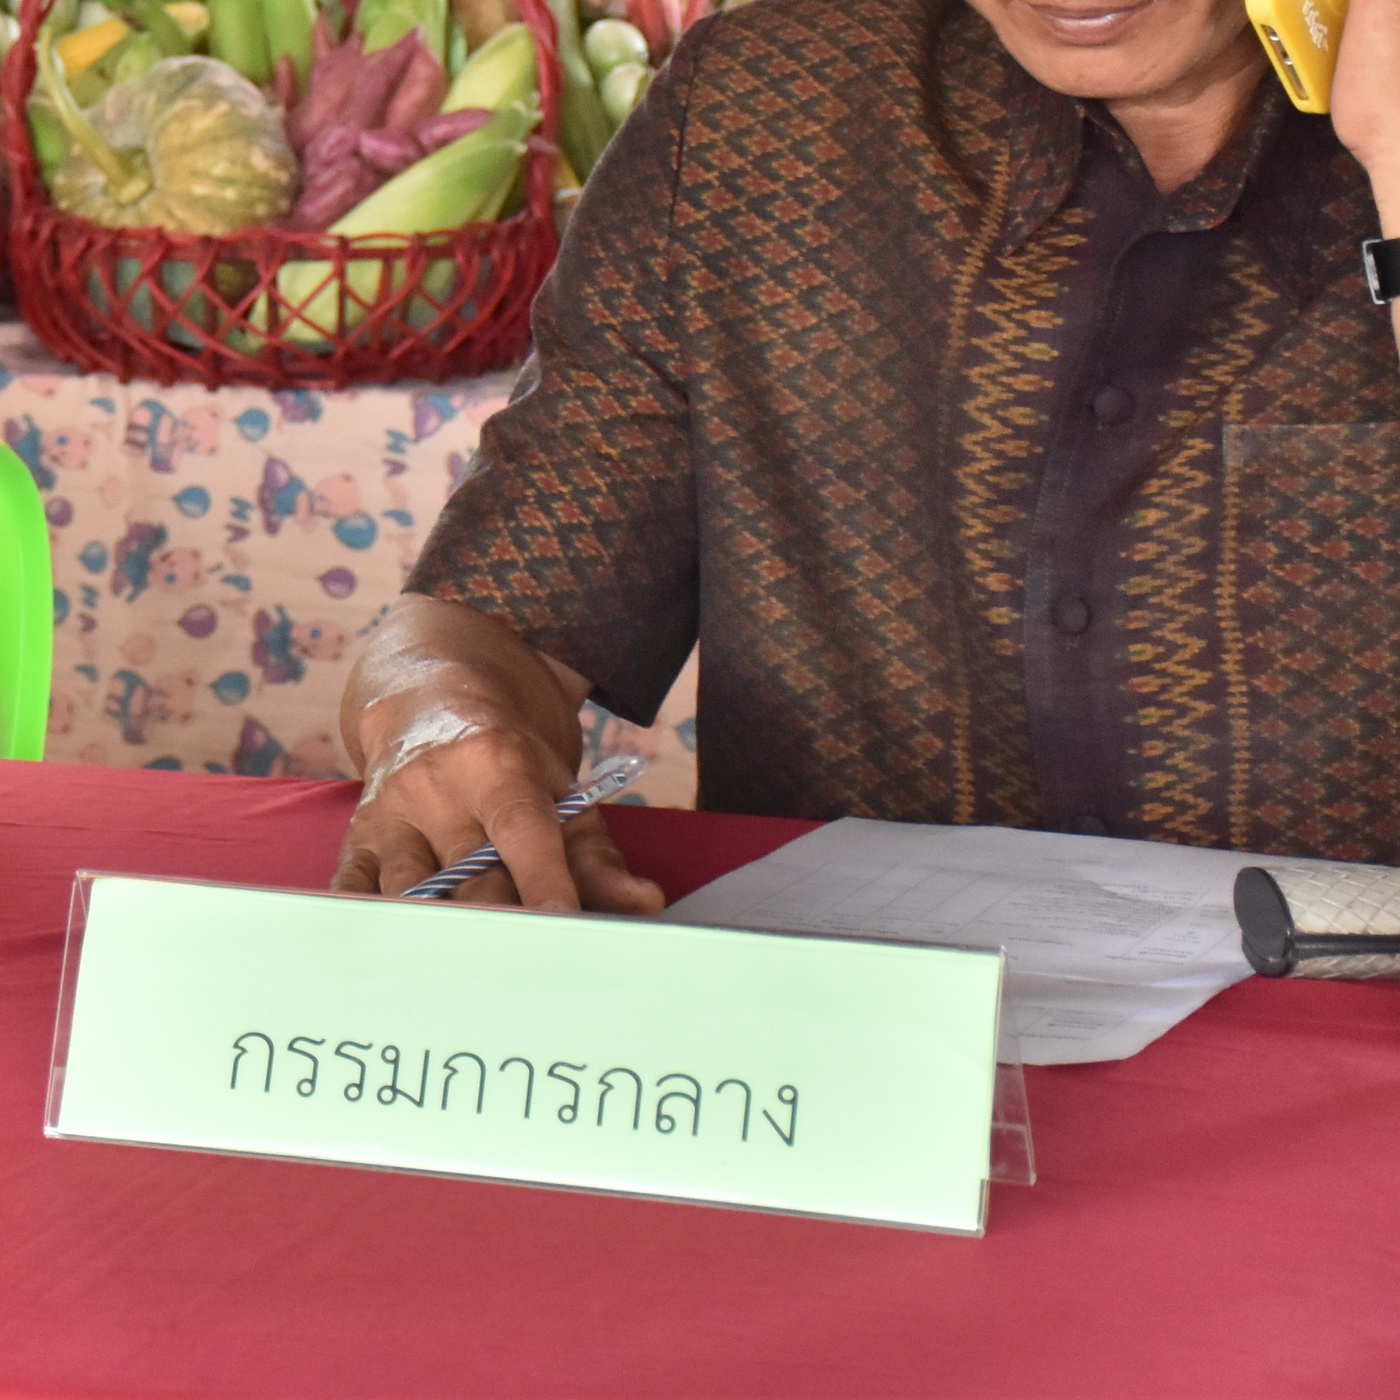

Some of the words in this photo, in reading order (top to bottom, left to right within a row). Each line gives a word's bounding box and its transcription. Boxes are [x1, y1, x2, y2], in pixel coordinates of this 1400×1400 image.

[228, 1030, 802, 1150] กรรมการกลาง
